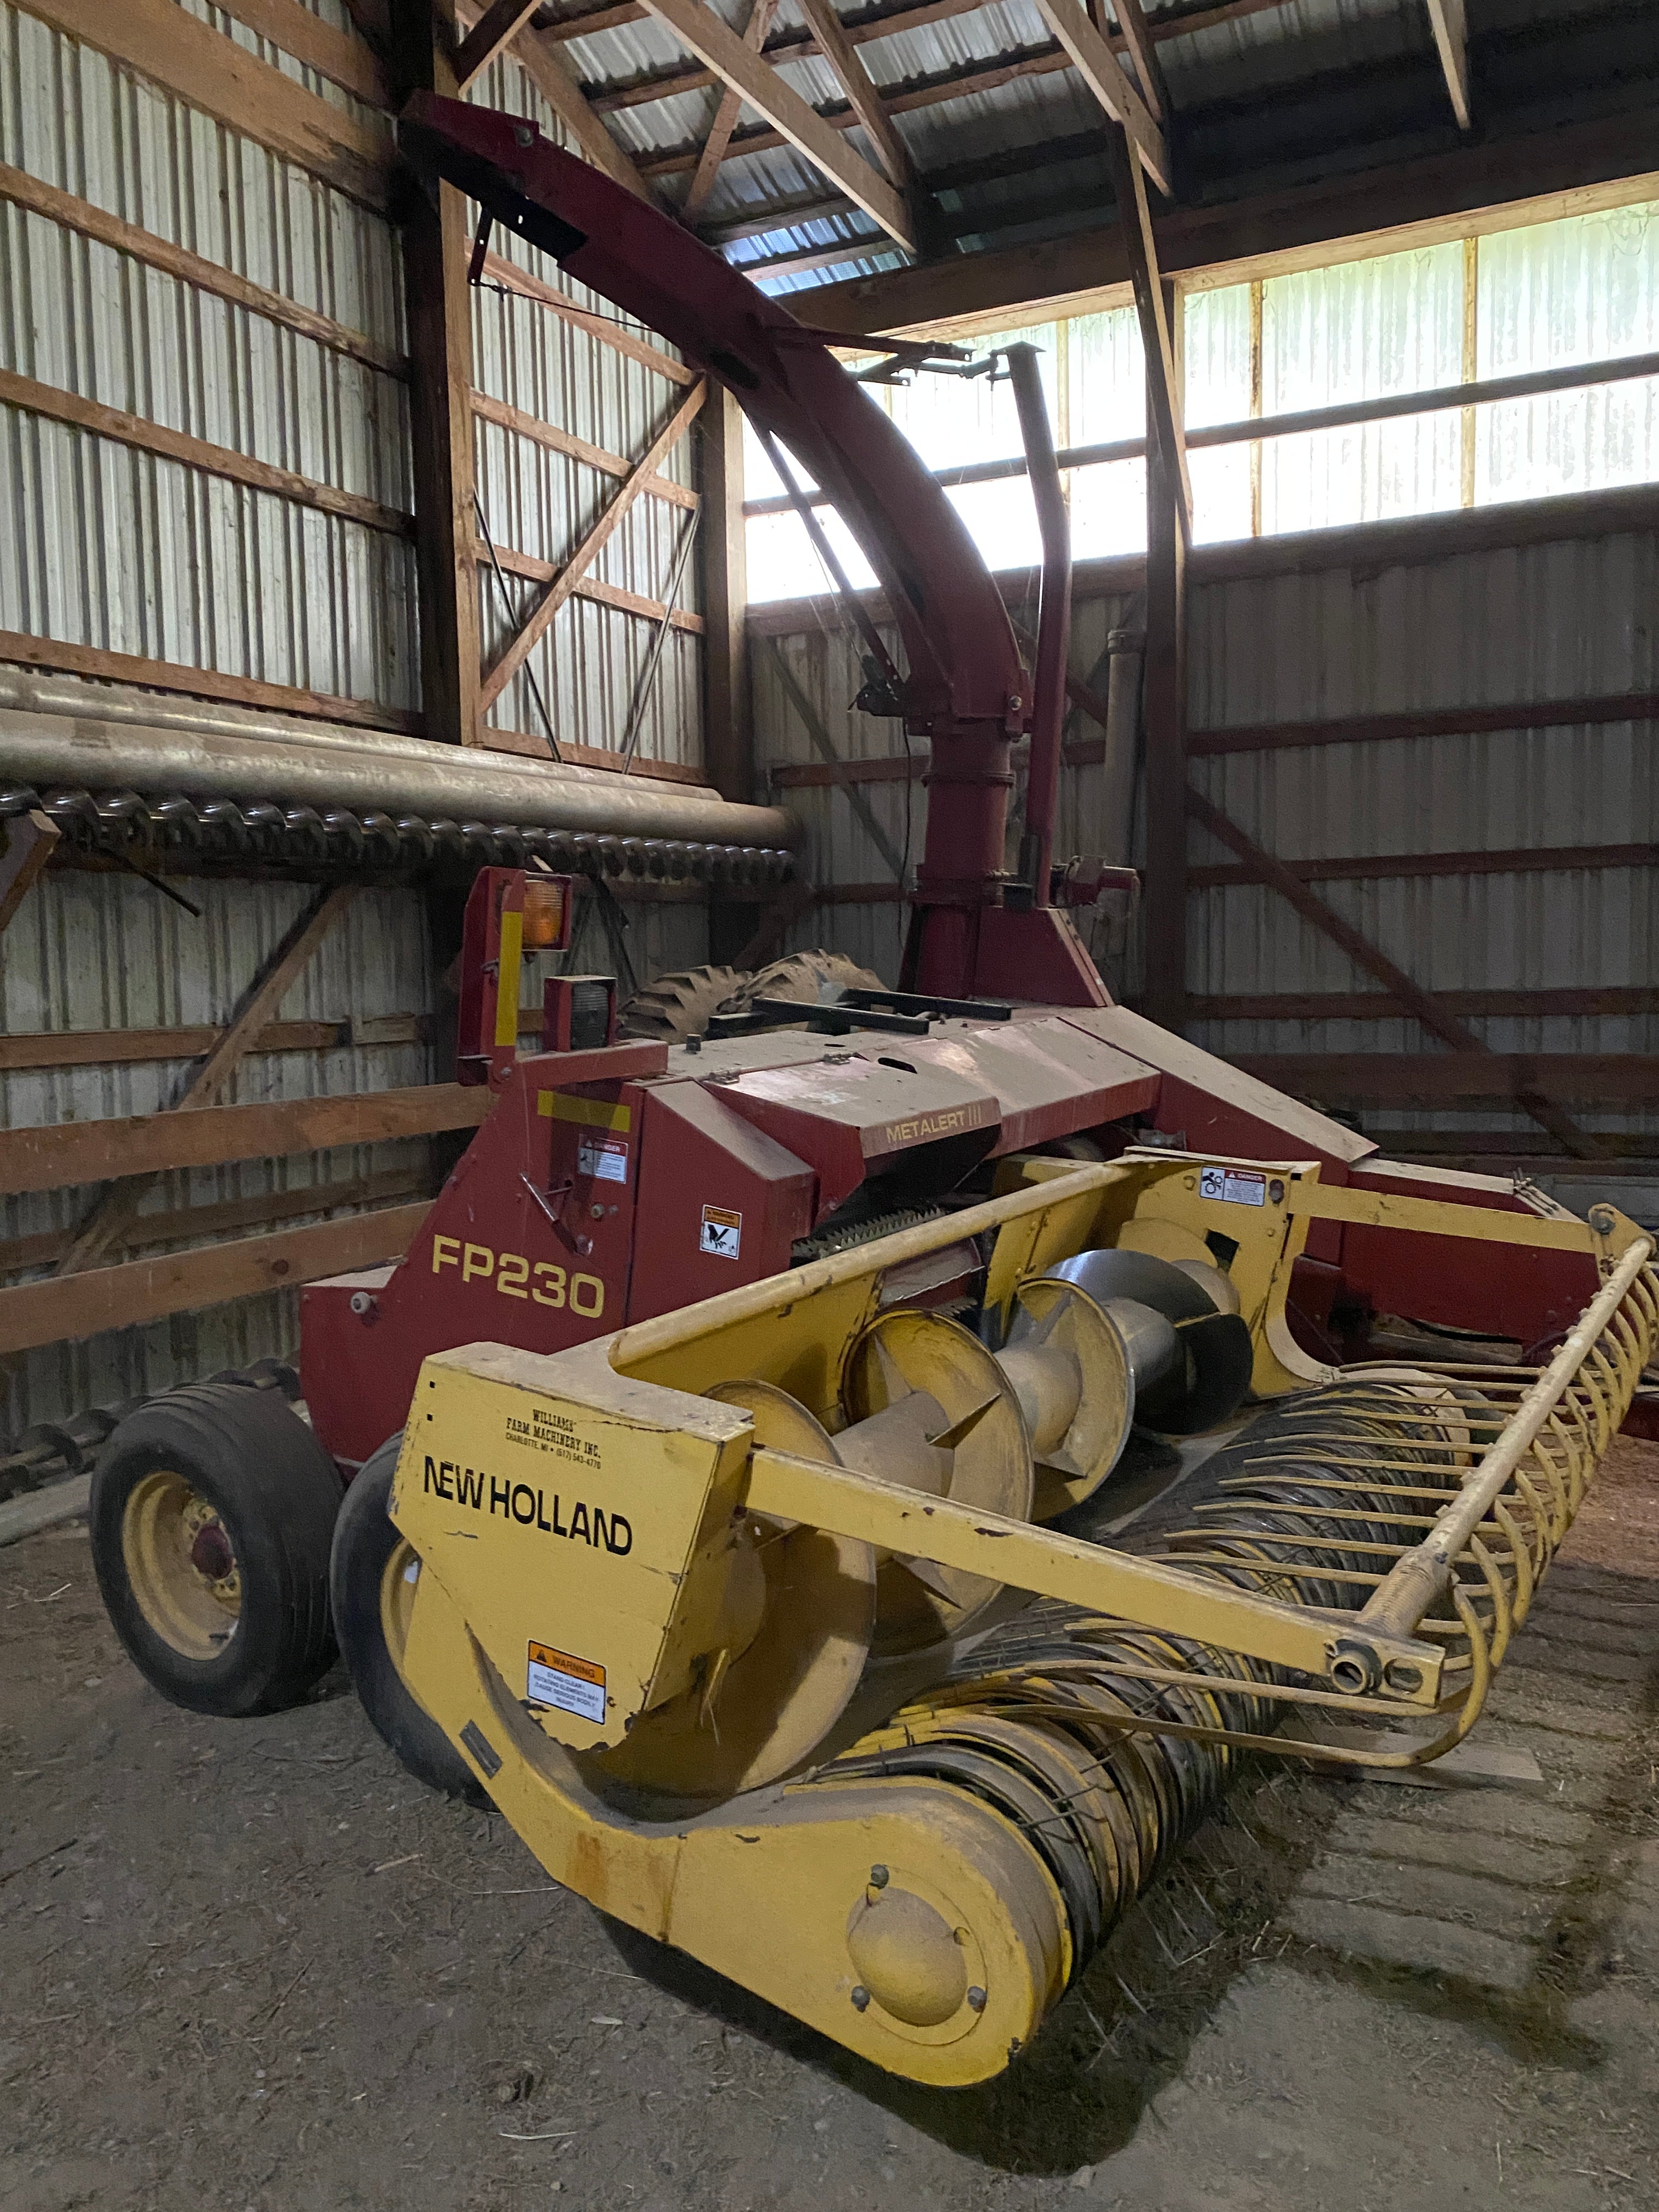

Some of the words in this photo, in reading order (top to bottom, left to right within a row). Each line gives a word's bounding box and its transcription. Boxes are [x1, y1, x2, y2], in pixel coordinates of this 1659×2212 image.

[886, 1110, 964, 1143] METALERT
[968, 1104, 982, 1126] III
[1238, 1173, 1262, 1181] DANGER
[432, 1234, 604, 1318] FP230
[506, 1418, 530, 1435] FARM
[533, 1425, 581, 1451] MACHINERY
[584, 1442, 601, 1458] INC.
[424, 1455, 484, 1510] NEW
[490, 1476, 633, 1556] HOLLAND
[552, 1655, 595, 1678] WARNING
